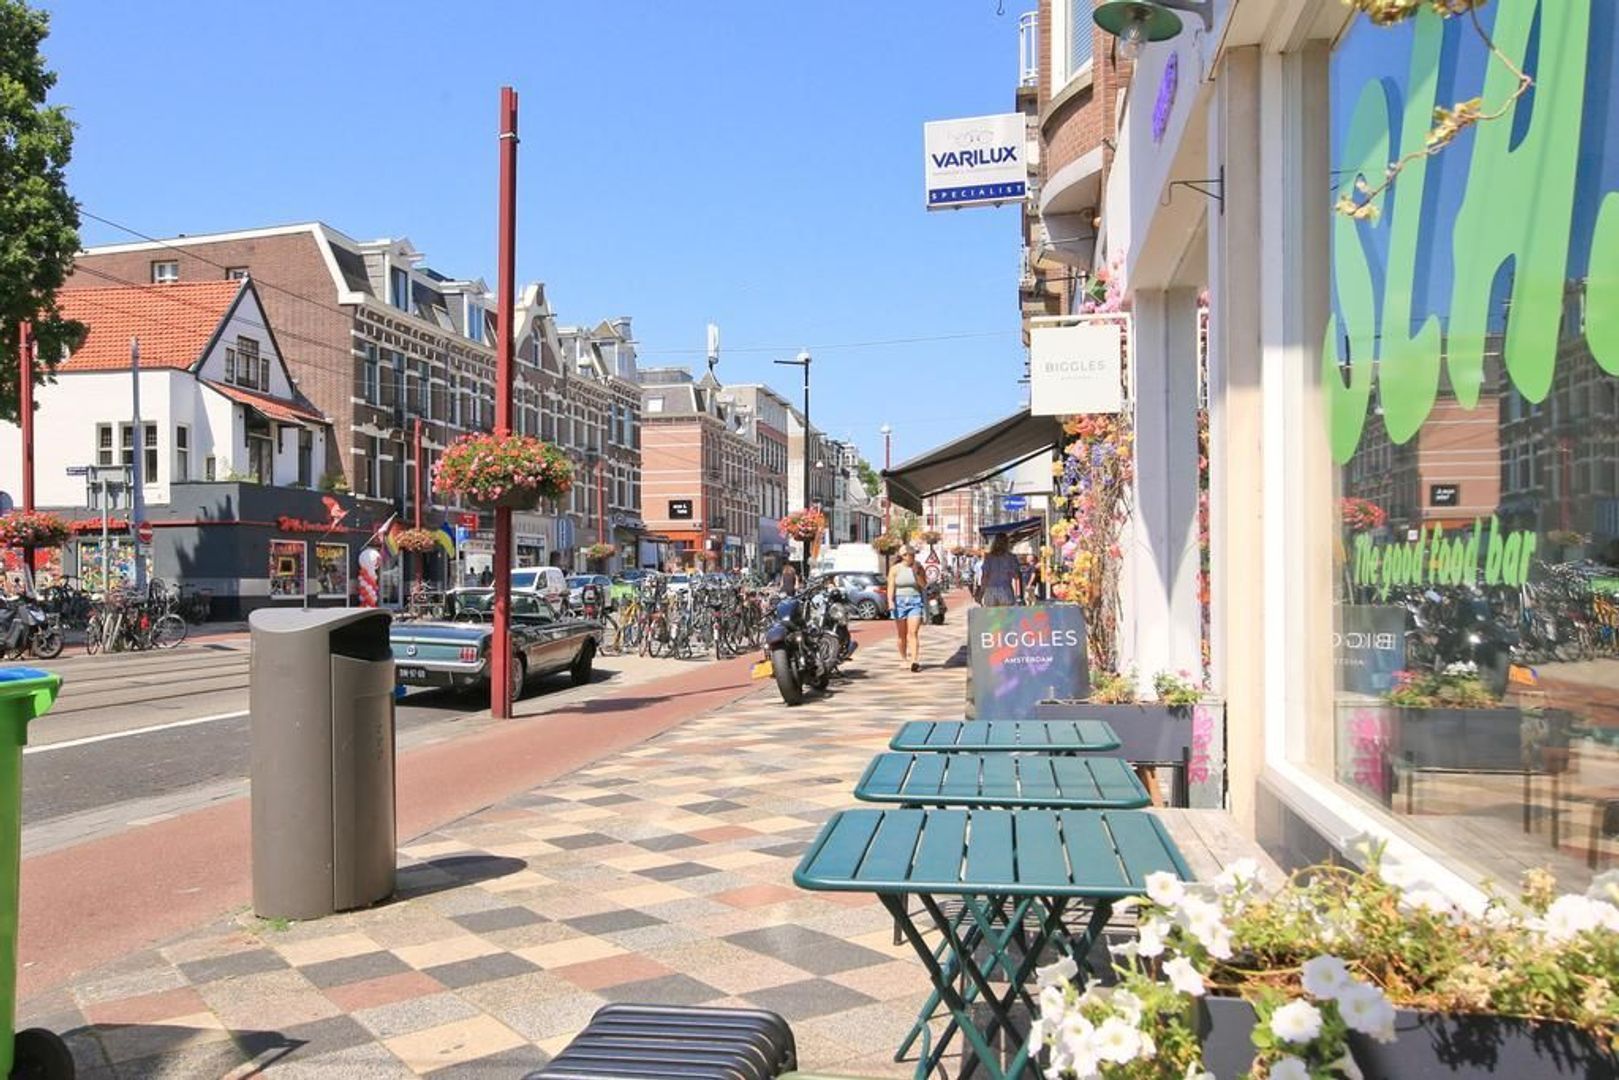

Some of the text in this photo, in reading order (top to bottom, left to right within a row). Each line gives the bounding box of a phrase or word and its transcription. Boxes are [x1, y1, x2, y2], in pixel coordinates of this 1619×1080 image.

[931, 146, 1017, 168] VARILUX
[931, 184, 1023, 200] SPECIALIST
[1320, 0, 1619, 466] SLA
[1044, 361, 1106, 373] BIGGLES
[1381, 523, 1427, 602] good
[1428, 520, 1482, 587] food
[1485, 514, 1537, 588] bar
[980, 630, 1078, 648] BIGGLES
[1003, 655, 1053, 665] AMSTERDAM
